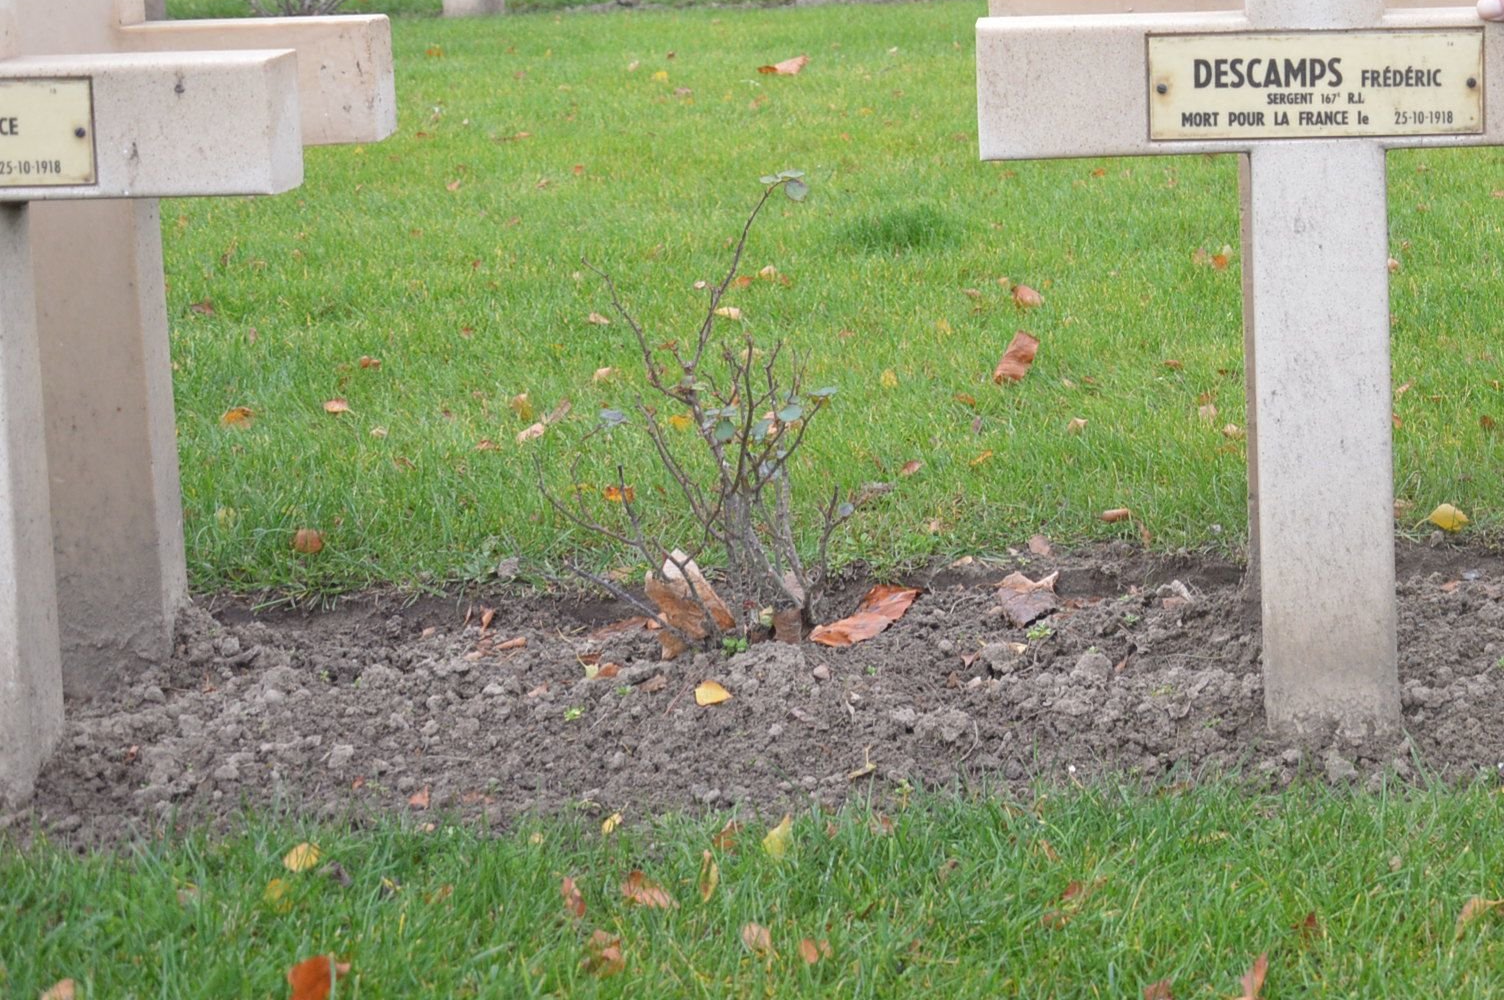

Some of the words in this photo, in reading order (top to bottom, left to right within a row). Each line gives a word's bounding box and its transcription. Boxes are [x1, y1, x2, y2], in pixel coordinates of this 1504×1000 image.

[1193, 57, 1343, 89] DESCAMPS
[1360, 65, 1443, 88] FRÉDÉRIC
[1266, 92, 1315, 105] SERGENT
[1181, 111, 1220, 127] MORT
[1228, 110, 1265, 127] POUR
[1273, 110, 1290, 126] LA
[1298, 110, 1349, 126] FRANCE
[1357, 110, 1370, 125] le
